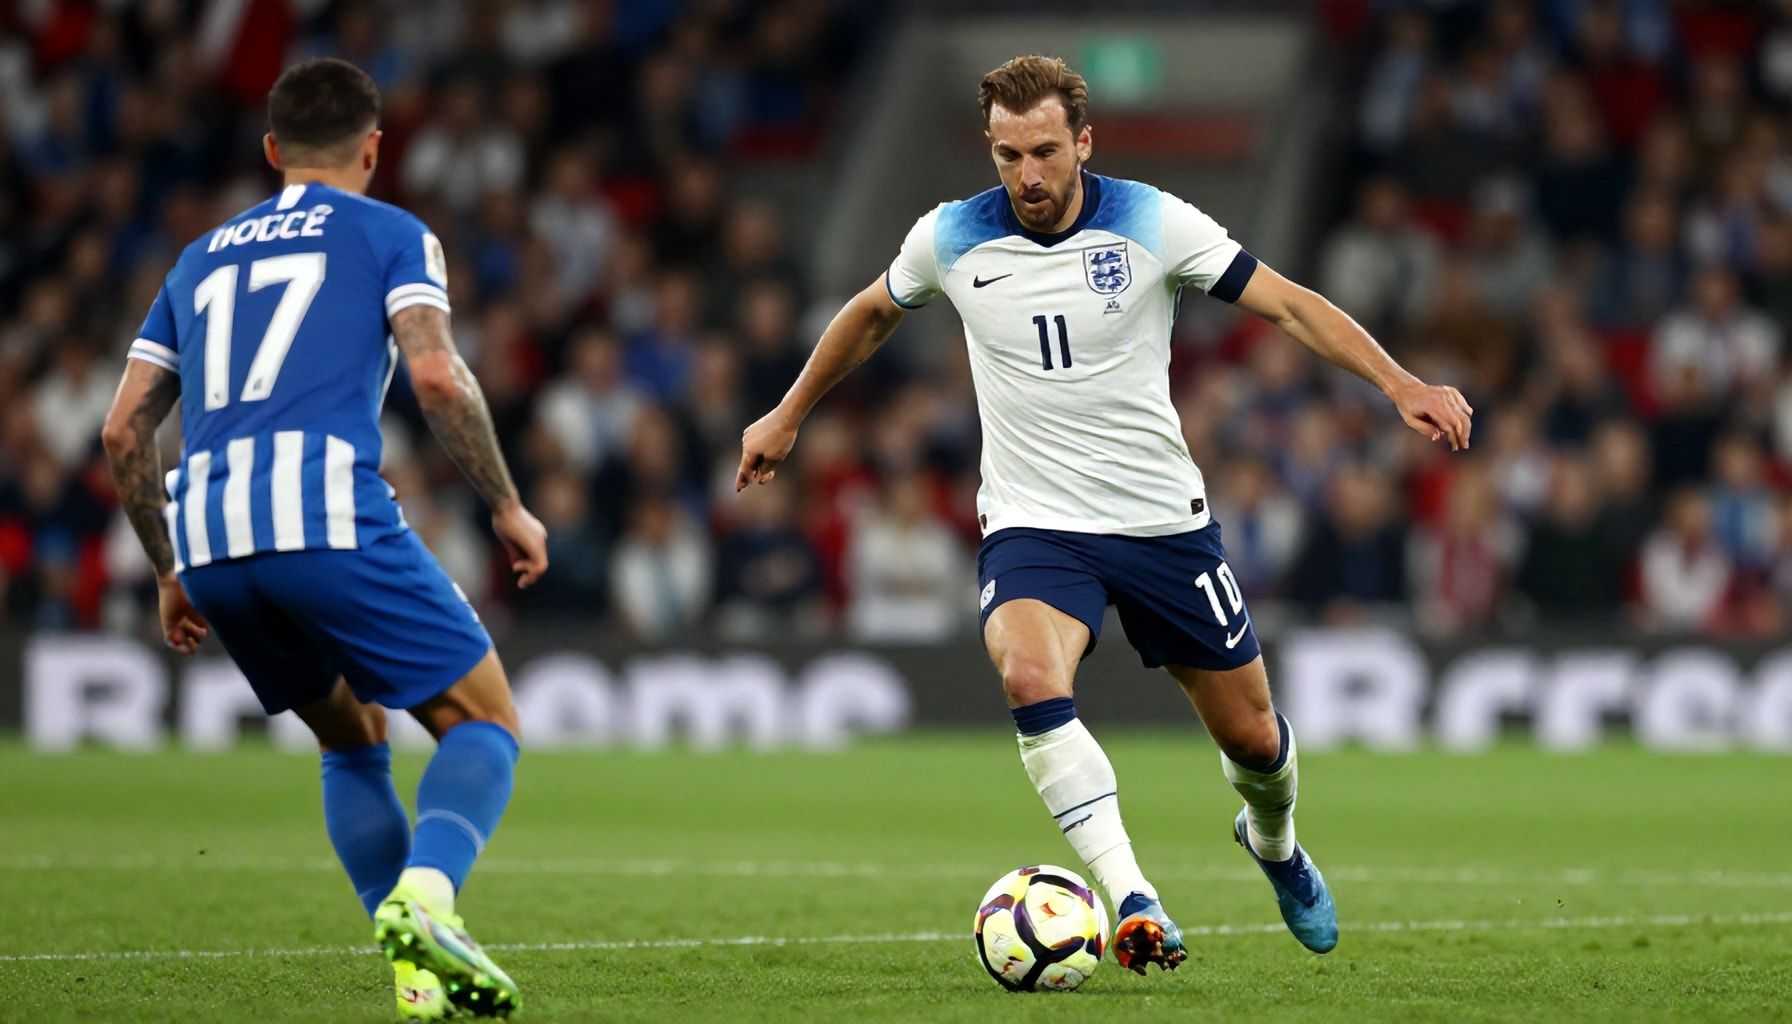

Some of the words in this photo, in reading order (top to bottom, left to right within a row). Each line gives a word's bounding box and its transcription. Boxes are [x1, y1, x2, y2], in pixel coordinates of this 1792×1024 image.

[194, 252, 327, 412] 17
[1032, 314, 1073, 371] 11
[1195, 561, 1243, 627] 10
